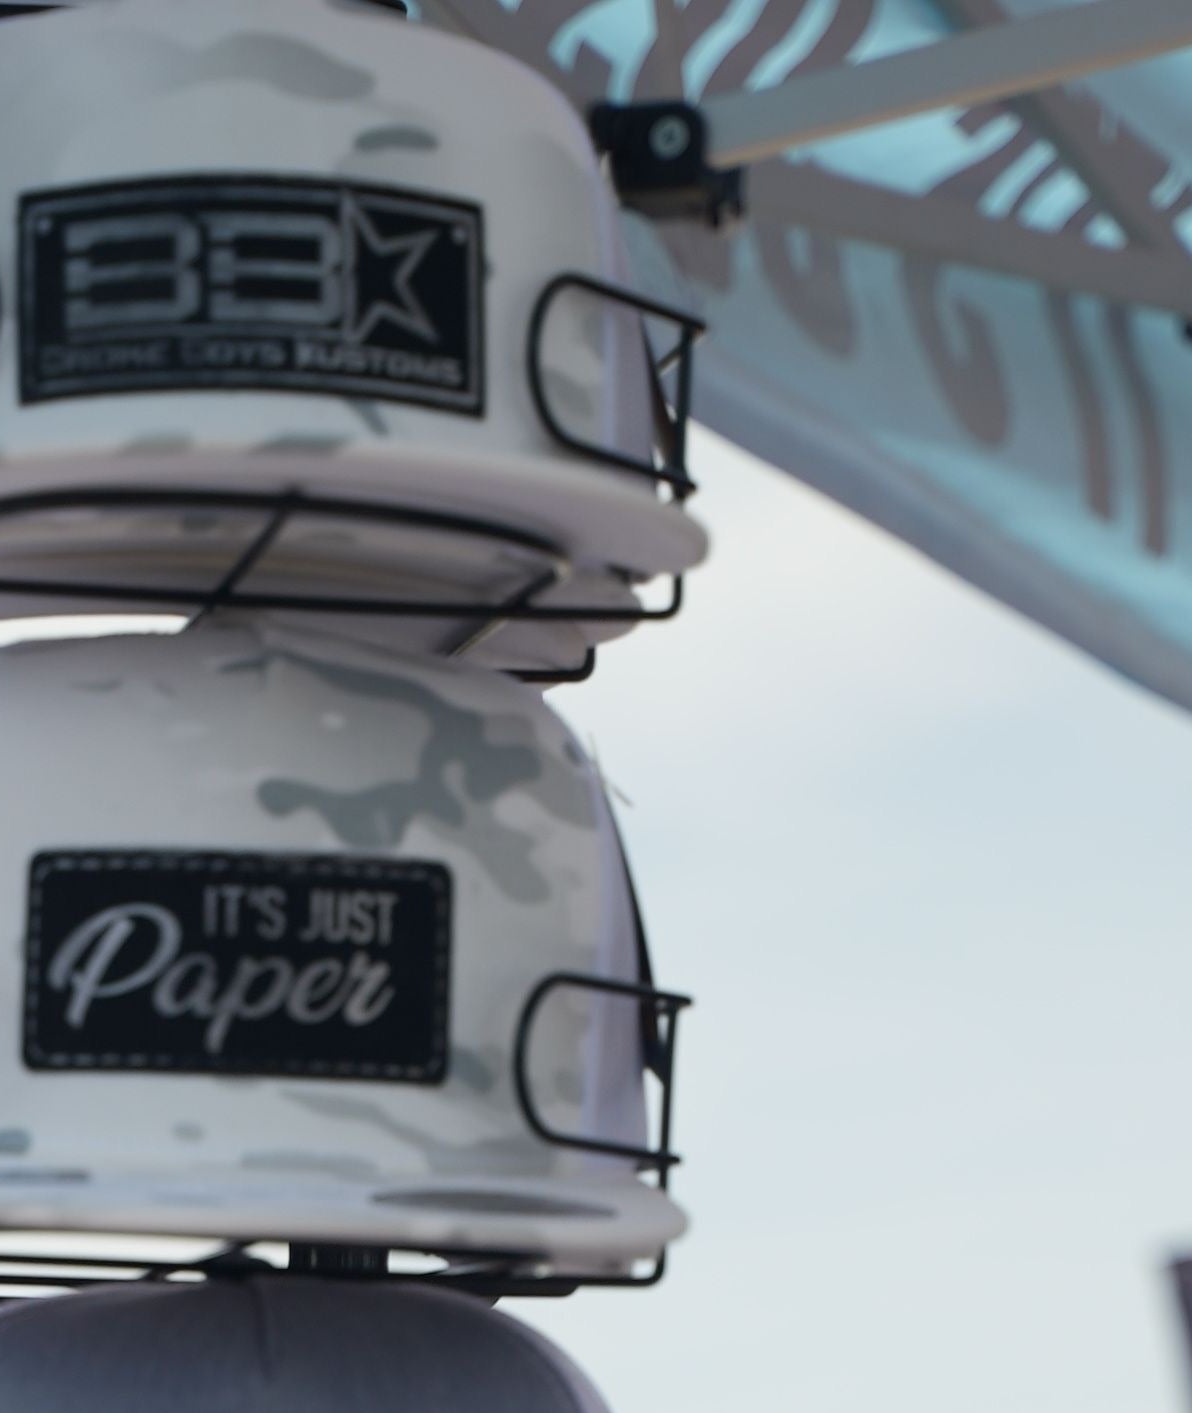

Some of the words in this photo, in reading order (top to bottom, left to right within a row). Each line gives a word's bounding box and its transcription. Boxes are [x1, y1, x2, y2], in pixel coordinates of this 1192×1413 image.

[294, 342, 464, 386] KUSTOMS
[202, 884, 287, 938] IT'S
[299, 888, 398, 945] JUST
[47, 903, 395, 1053] Paper
